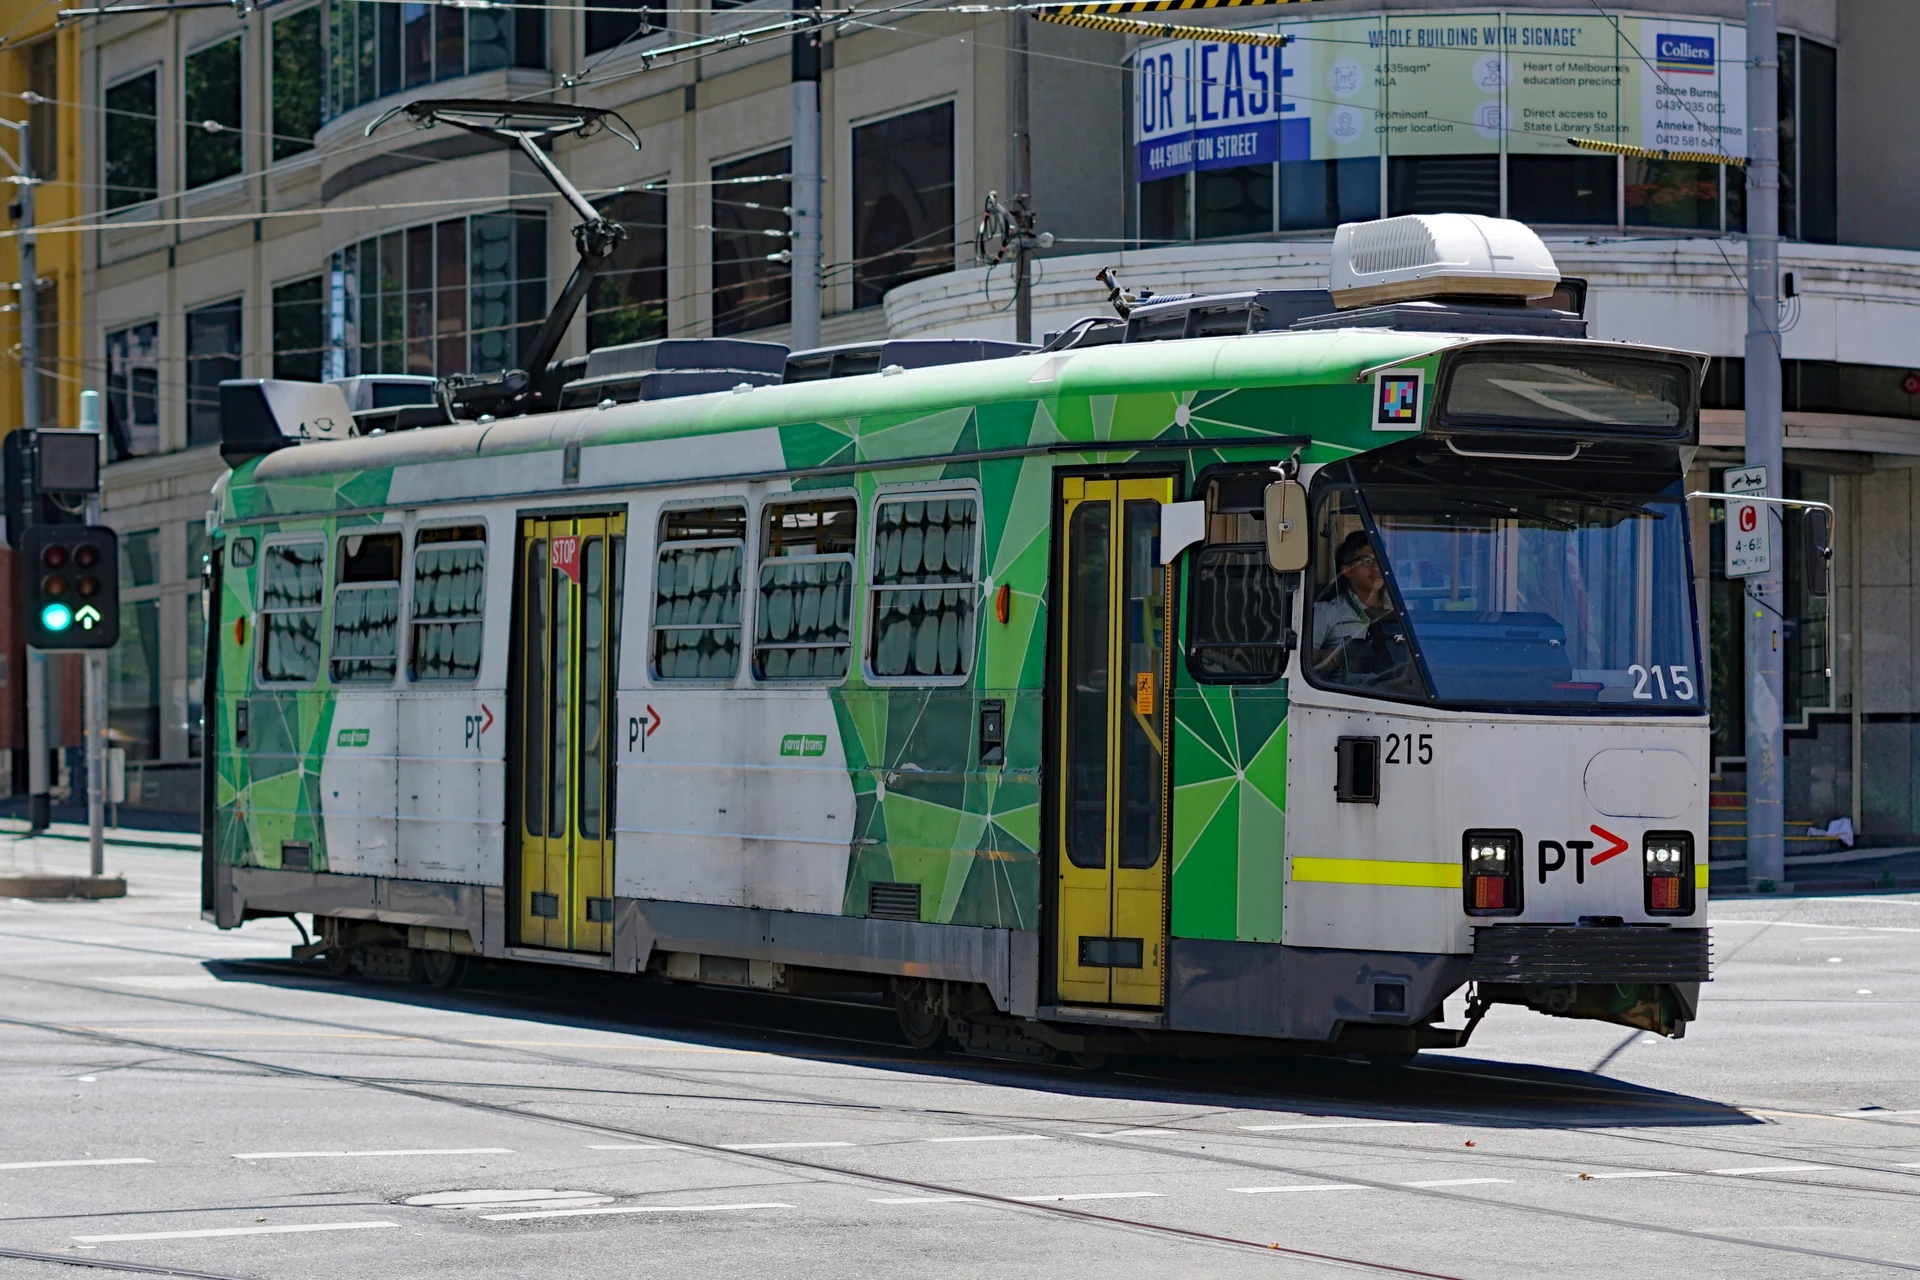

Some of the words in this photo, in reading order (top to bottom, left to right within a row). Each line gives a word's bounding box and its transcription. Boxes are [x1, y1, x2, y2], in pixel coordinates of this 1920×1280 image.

[1418, 28, 1478, 46] BUILDING
[1483, 27, 1516, 45] WITH
[1661, 41, 1710, 59] Colliers
[1523, 62, 1552, 71] Heart
[1555, 62, 1566, 71] of
[1136, 53, 1173, 133] OR
[1186, 35, 1295, 124] LEASE
[1375, 77, 1396, 87] NLA
[1523, 76, 1576, 85] education
[1578, 77, 1621, 87] precinct
[1656, 85, 1687, 96] Shane
[1690, 87, 1719, 98] Burns
[1656, 100, 1682, 111] 0439
[1685, 101, 1704, 112] 035
[1375, 110, 1428, 120] Prominent
[1524, 108, 1555, 118] Direct
[1597, 110, 1608, 119] to
[1375, 125, 1408, 134] corner
[1411, 122, 1453, 133] location
[1524, 122, 1552, 131] State
[1554, 122, 1591, 134] Library
[1594, 123, 1629, 133] Staton
[1656, 120, 1694, 132] Anneke
[1656, 135, 1680, 145] 0412
[1682, 136, 1699, 146] 581
[1149, 146, 1164, 170] 444
[1217, 132, 1258, 159] STREET
[553, 539, 576, 565] STOP
[1628, 665, 1694, 700] 215
[1385, 733, 1433, 765] 215
